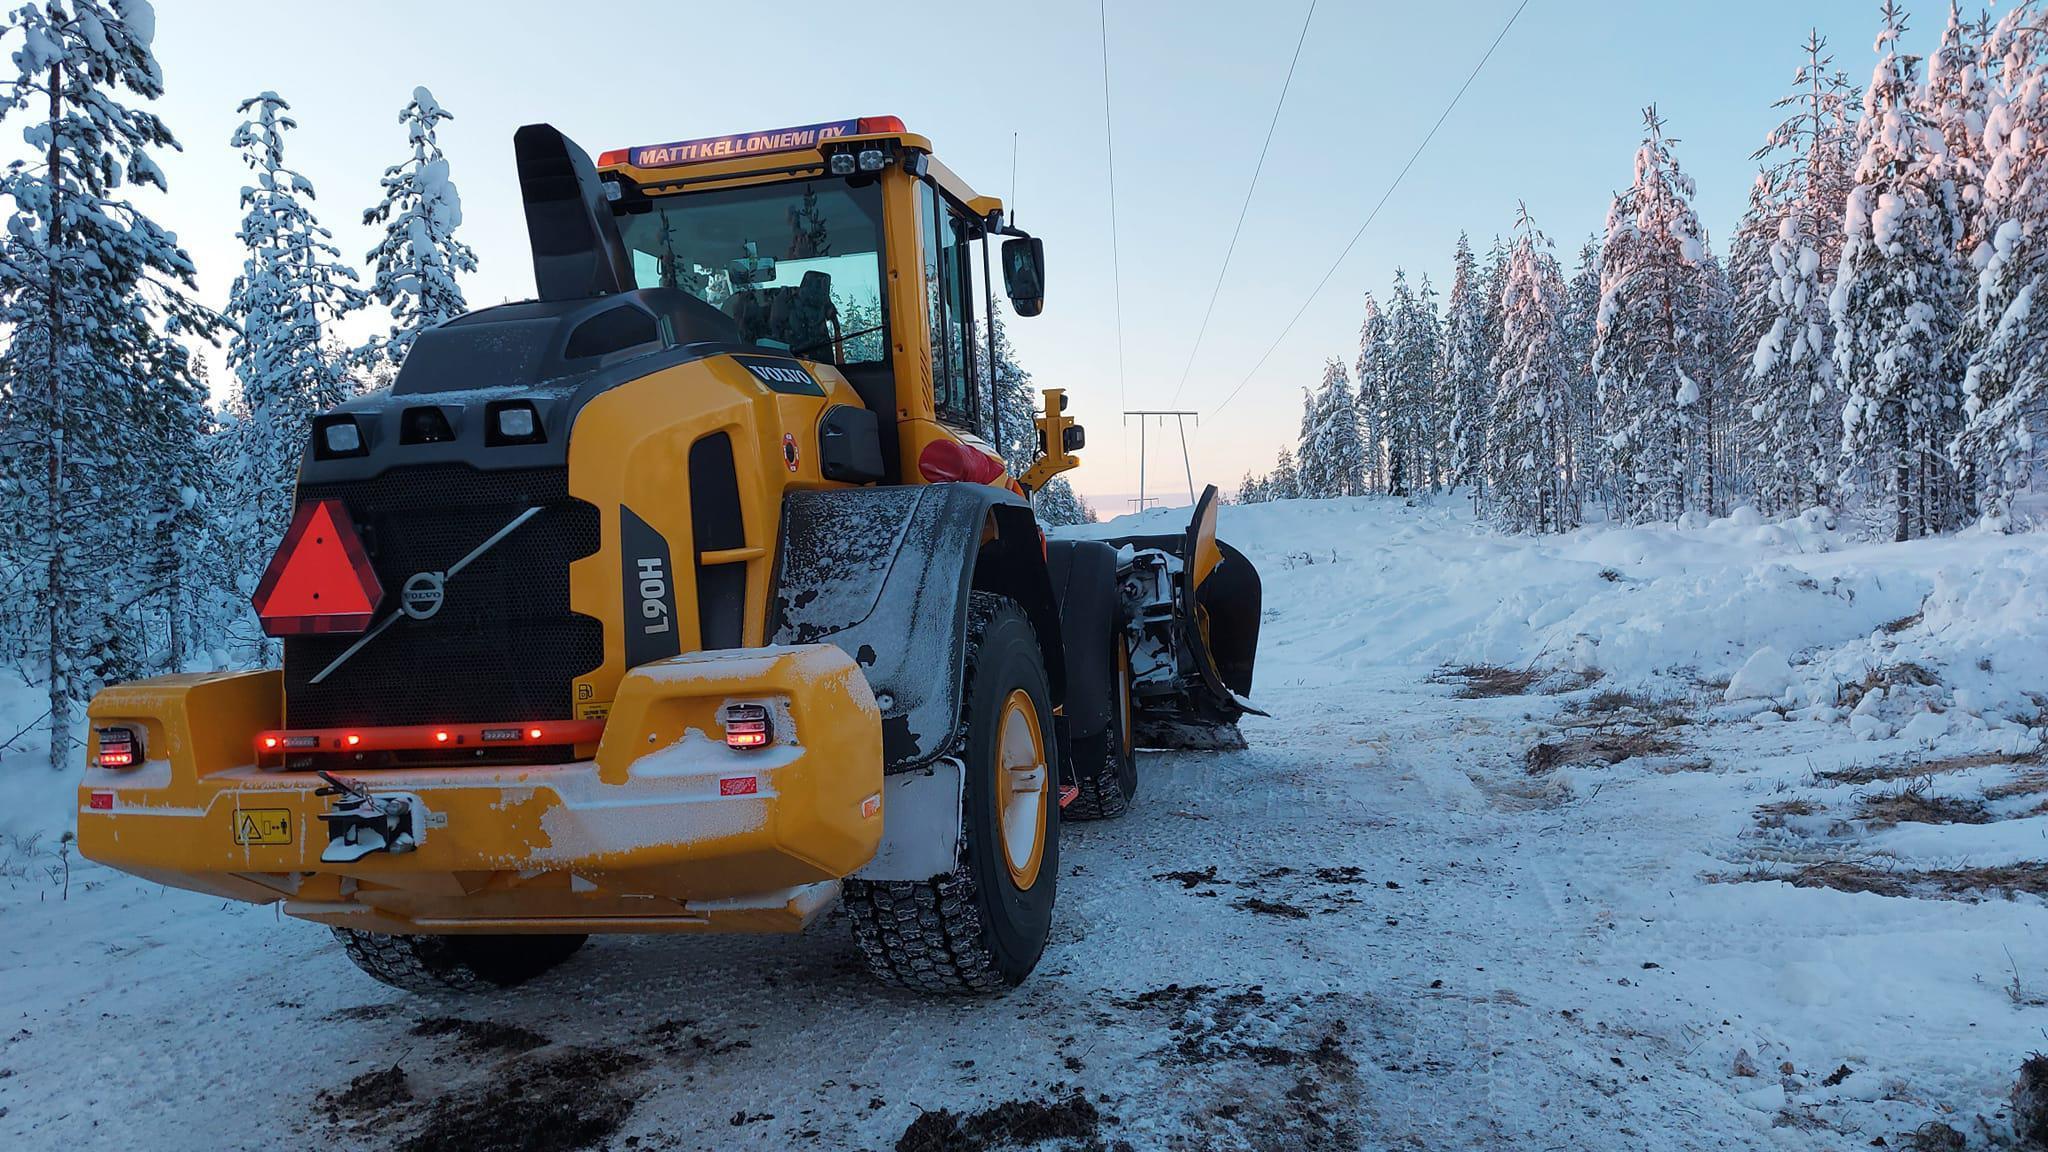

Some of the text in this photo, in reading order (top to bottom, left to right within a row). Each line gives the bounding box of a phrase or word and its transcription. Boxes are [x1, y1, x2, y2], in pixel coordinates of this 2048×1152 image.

[639, 125, 847, 165] MATTI KELLONIEMI OY
[748, 364, 813, 386] VOLVO
[404, 591, 442, 600] VOLVO
[637, 557, 670, 635] L90H
